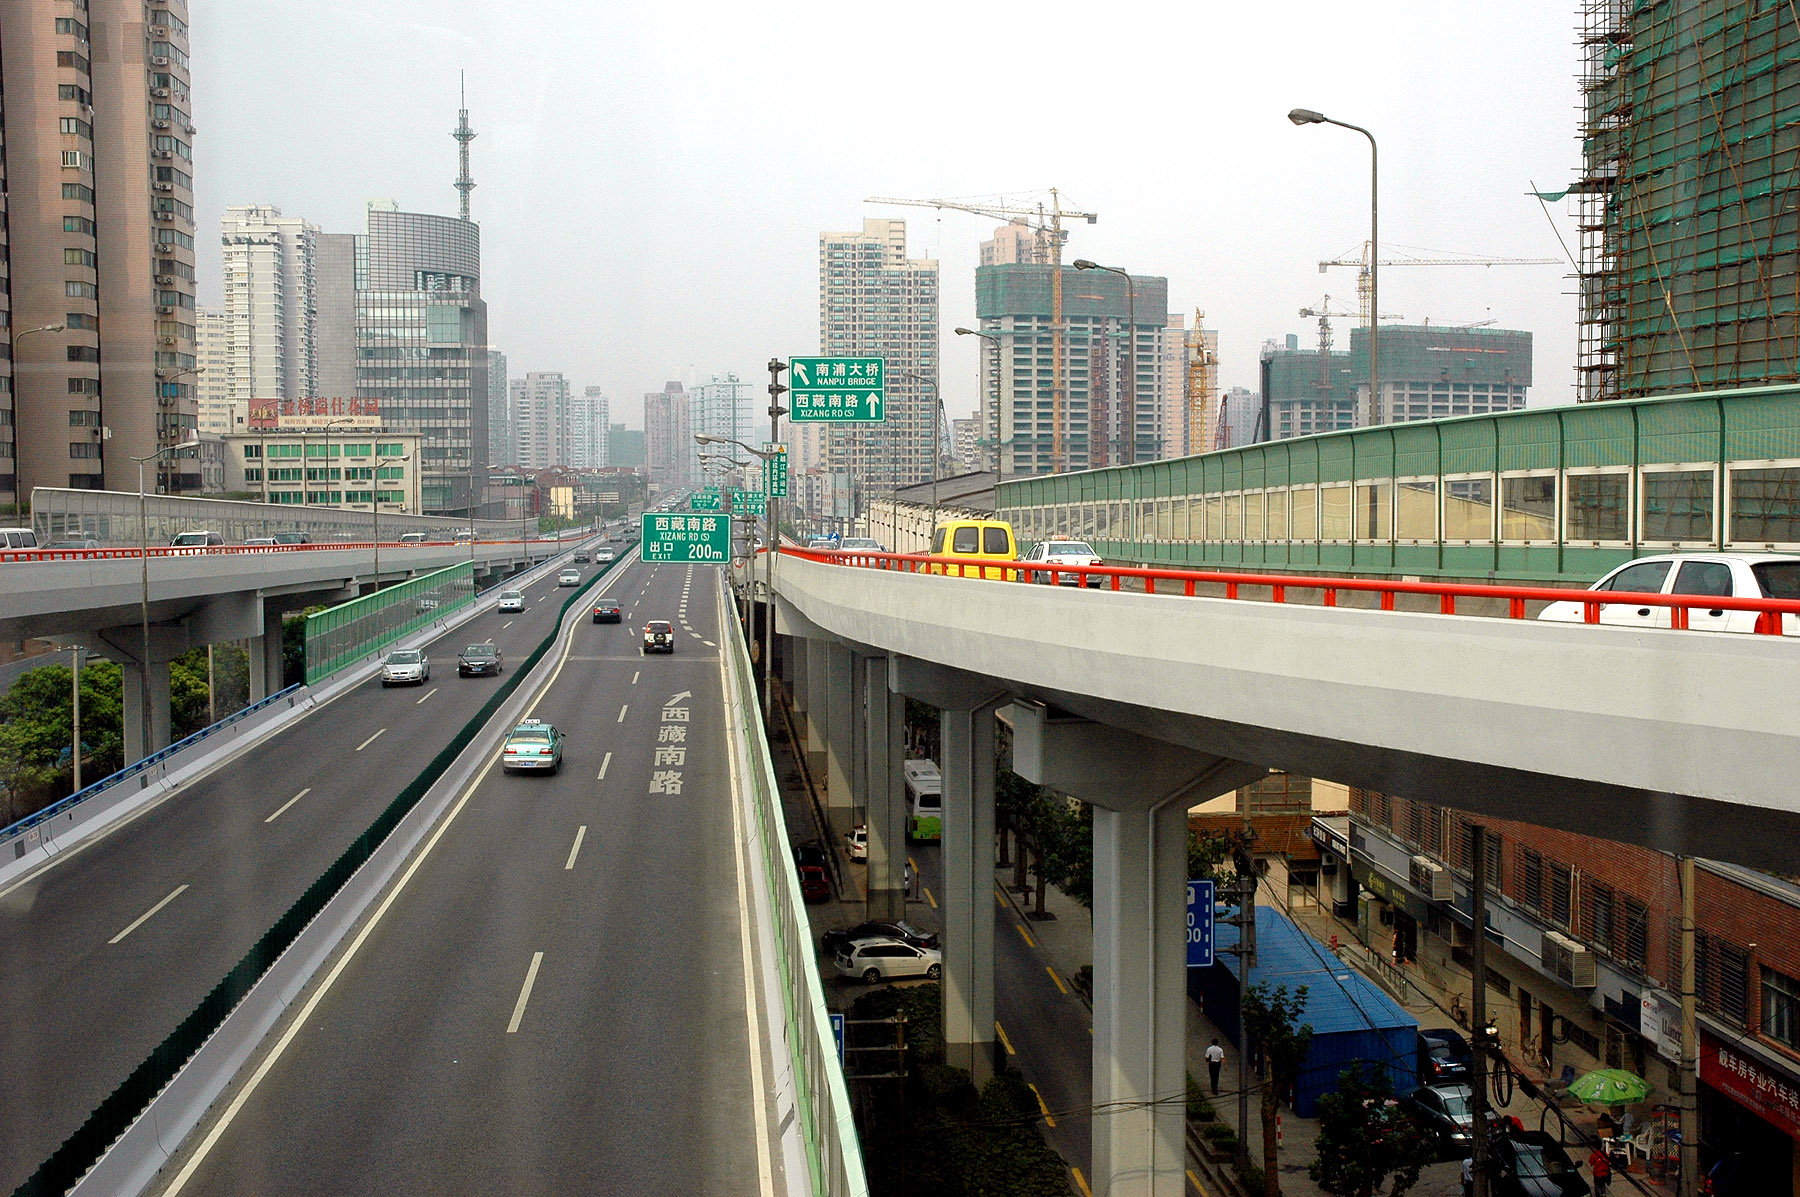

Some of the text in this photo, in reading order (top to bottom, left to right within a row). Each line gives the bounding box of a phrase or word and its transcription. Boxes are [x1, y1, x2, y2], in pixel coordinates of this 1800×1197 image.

[816, 362, 879, 376] 南浦大桥
[817, 377, 876, 385] NANPU BRIDGE
[795, 393, 858, 408] 西藏南路
[800, 409, 855, 417] XIZANG RD (S)
[655, 517, 717, 532] 西藏南路
[660, 532, 710, 541] XIZANG RD (S)
[650, 541, 674, 552] 出口
[688, 544, 723, 559] 200m
[649, 707, 690, 795] 西藏南路
